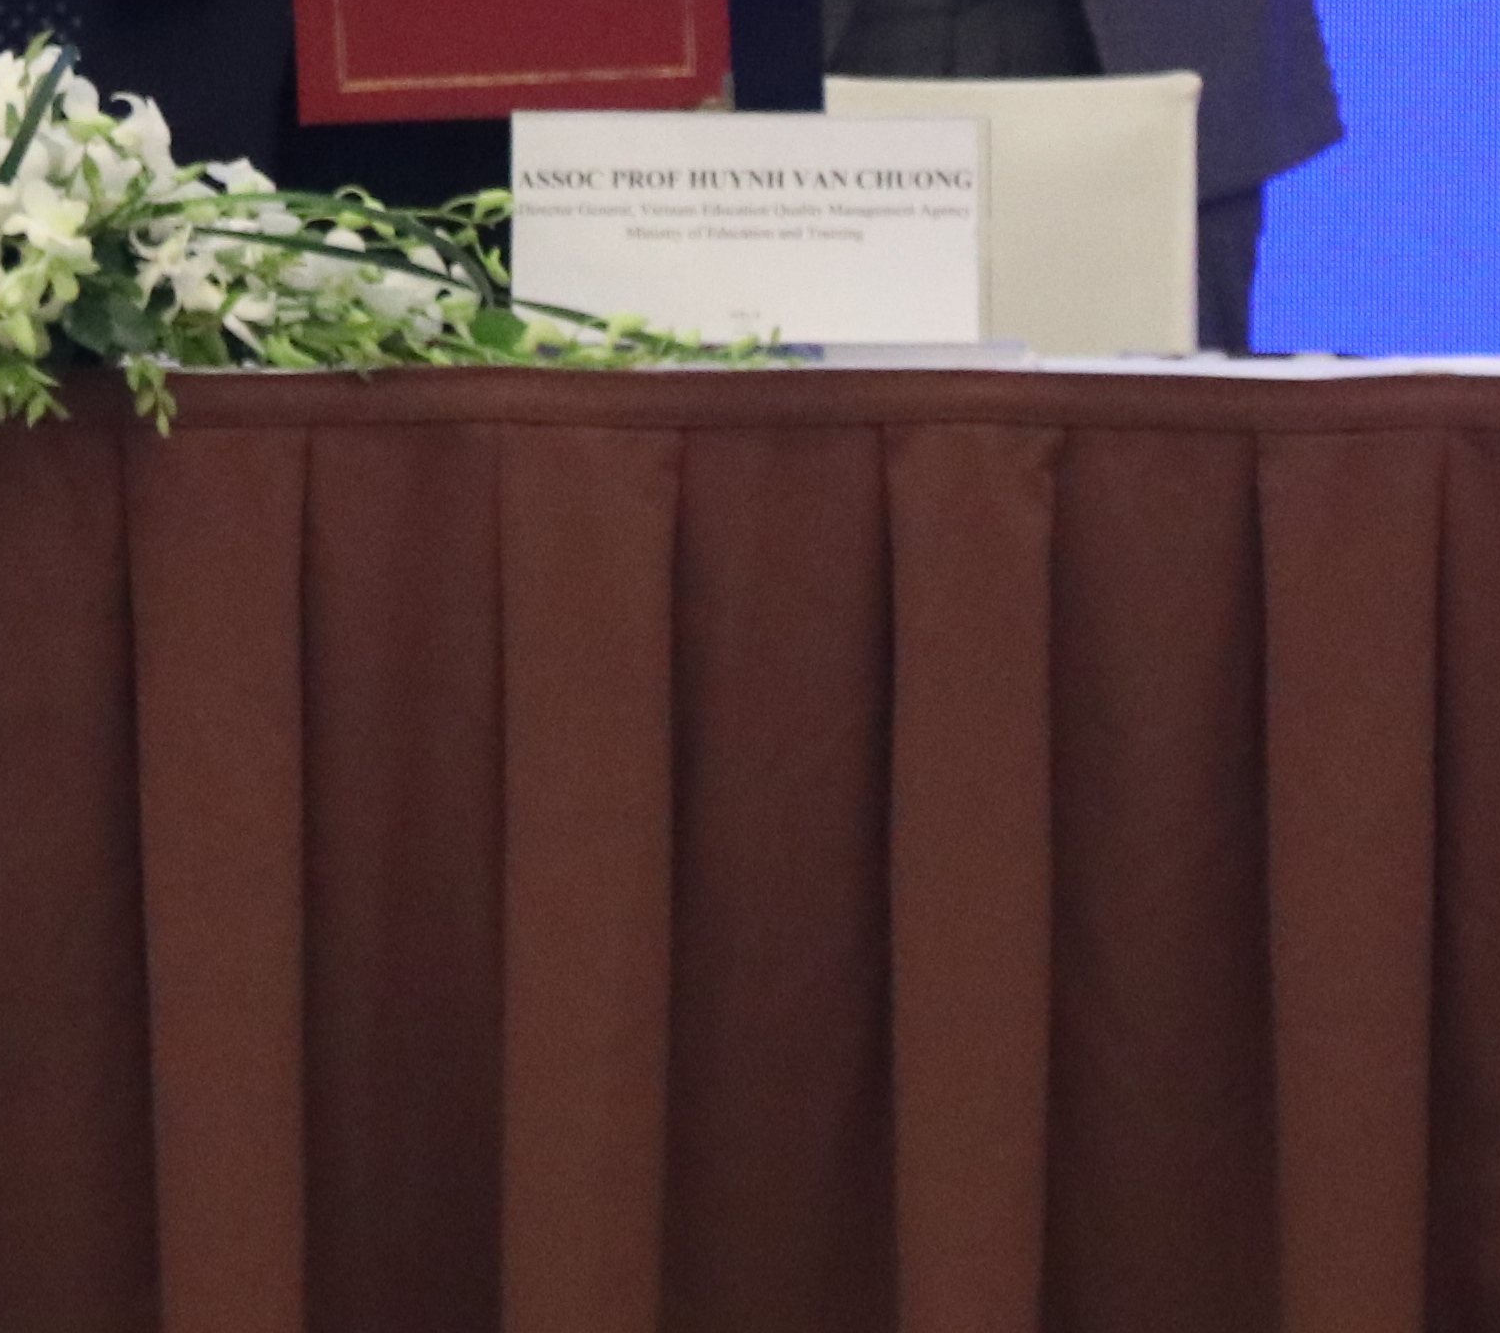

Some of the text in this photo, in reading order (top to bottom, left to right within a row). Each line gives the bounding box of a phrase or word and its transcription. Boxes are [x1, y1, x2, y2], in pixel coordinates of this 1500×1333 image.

[521, 169, 973, 190] ASSOC PROF HUYNH VAN CHUONG
